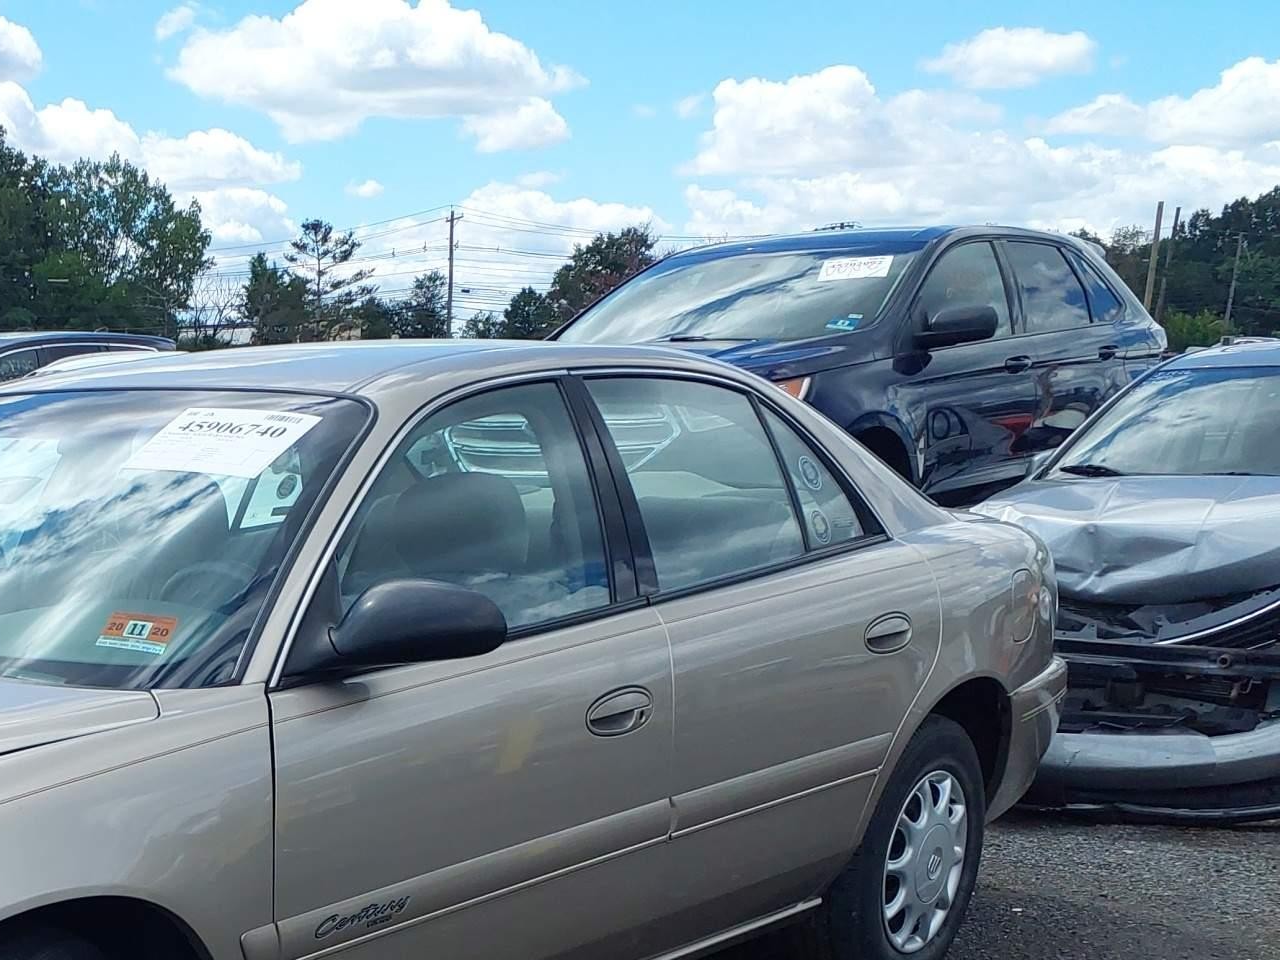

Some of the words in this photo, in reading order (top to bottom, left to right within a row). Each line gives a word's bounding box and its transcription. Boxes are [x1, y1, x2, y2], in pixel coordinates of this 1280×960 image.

[178, 420, 287, 438] 45906740
[107, 622, 124, 632] 20
[127, 623, 147, 637] 11
[152, 627, 169, 637] 20
[314, 896, 411, 938] Century
